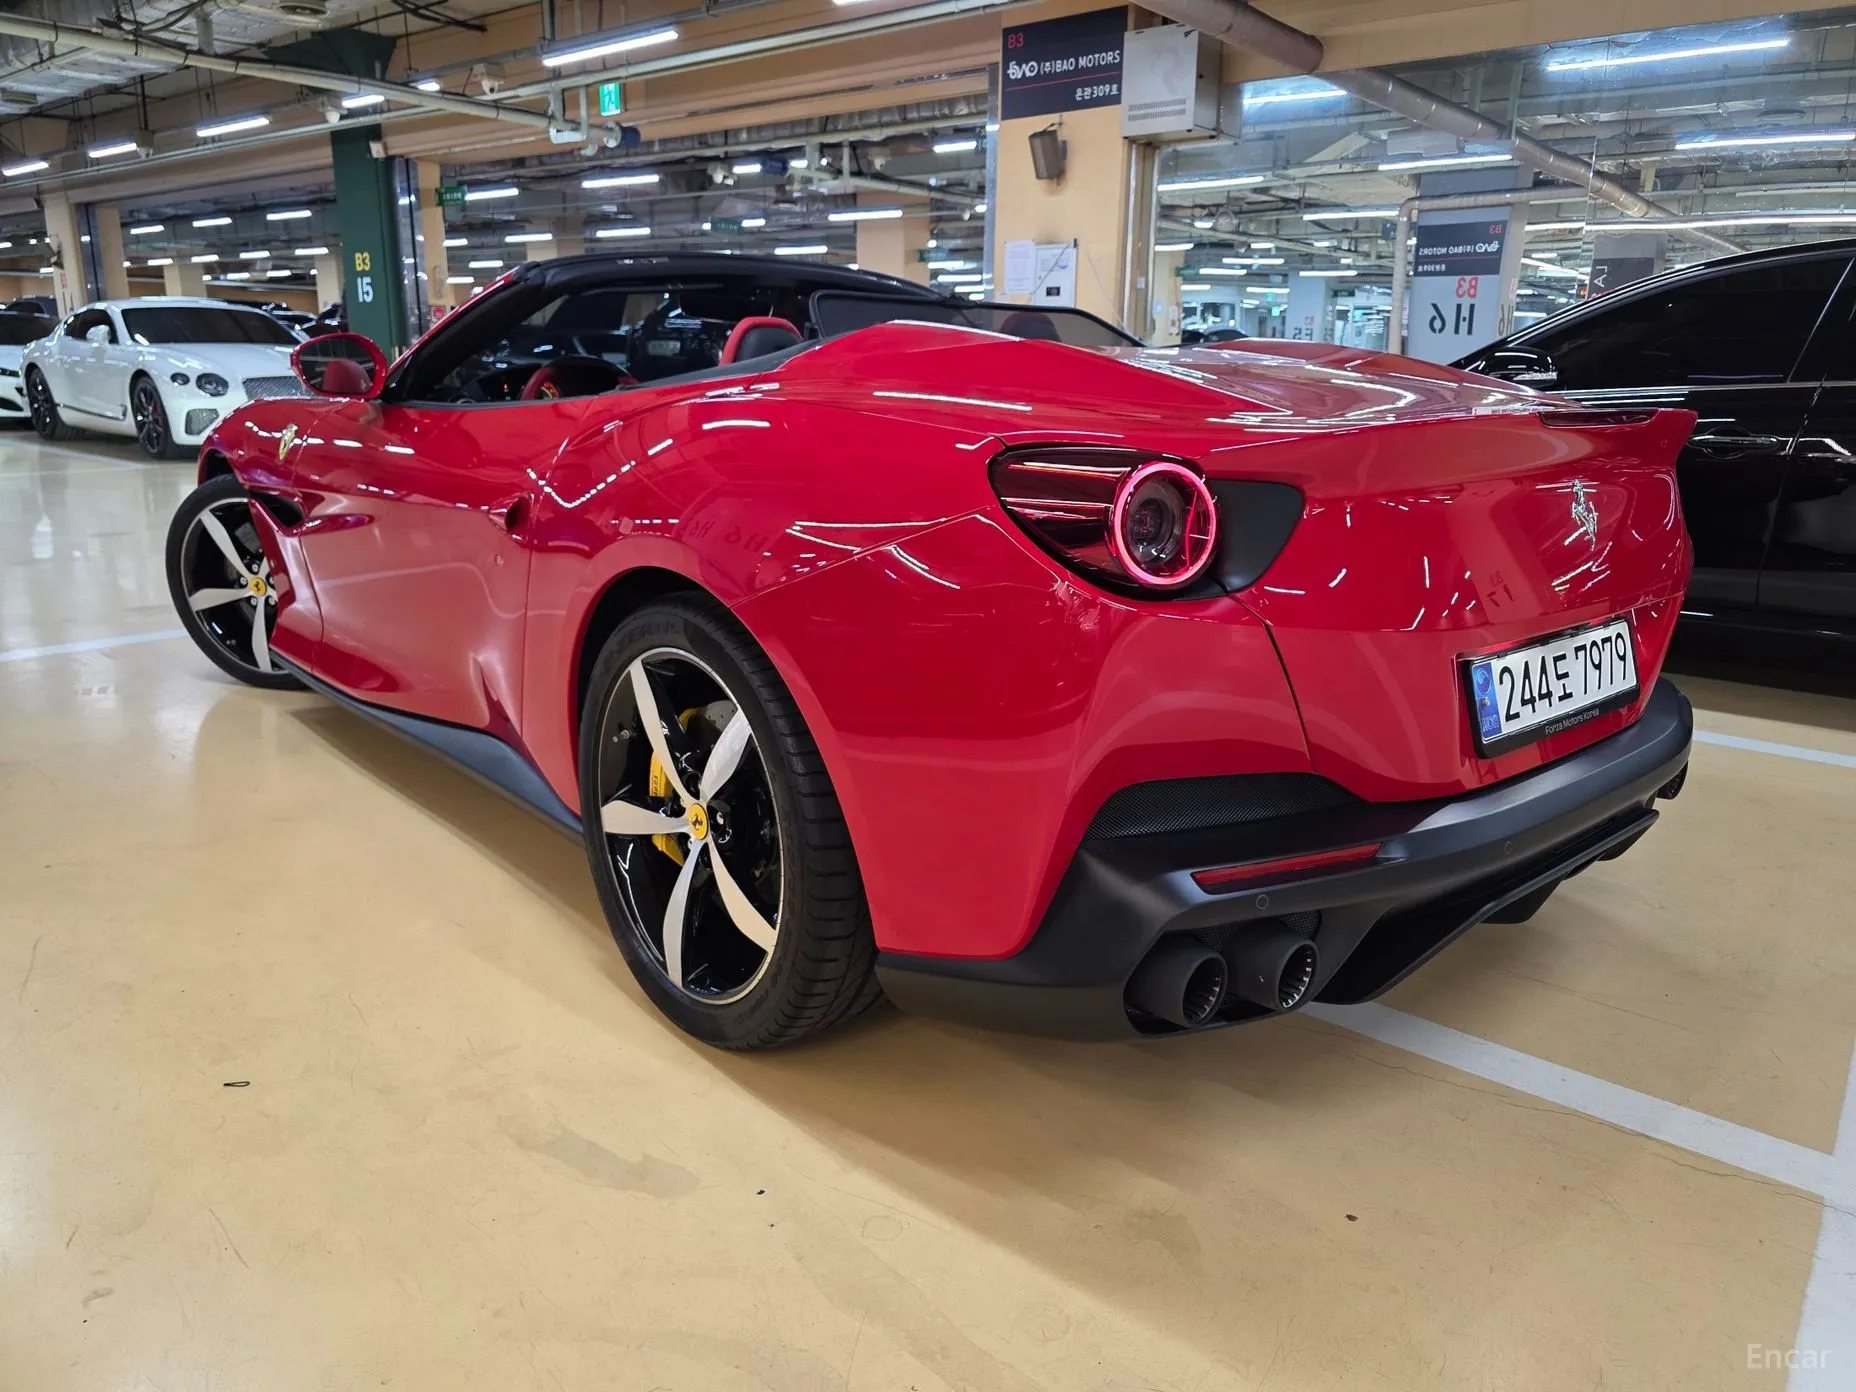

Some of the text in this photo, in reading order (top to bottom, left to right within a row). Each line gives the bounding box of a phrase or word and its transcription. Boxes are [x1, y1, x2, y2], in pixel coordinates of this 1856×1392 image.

[1007, 32, 1024, 48] B3
[1040, 58, 1075, 75] (주)BAO
[1078, 50, 1121, 69] MOTORS
[354, 251, 371, 272] B3
[357, 276, 374, 303] 15
[1499, 632, 1627, 723] 244도 7979
[1545, 708, 1600, 735] Forza Motors Korea
